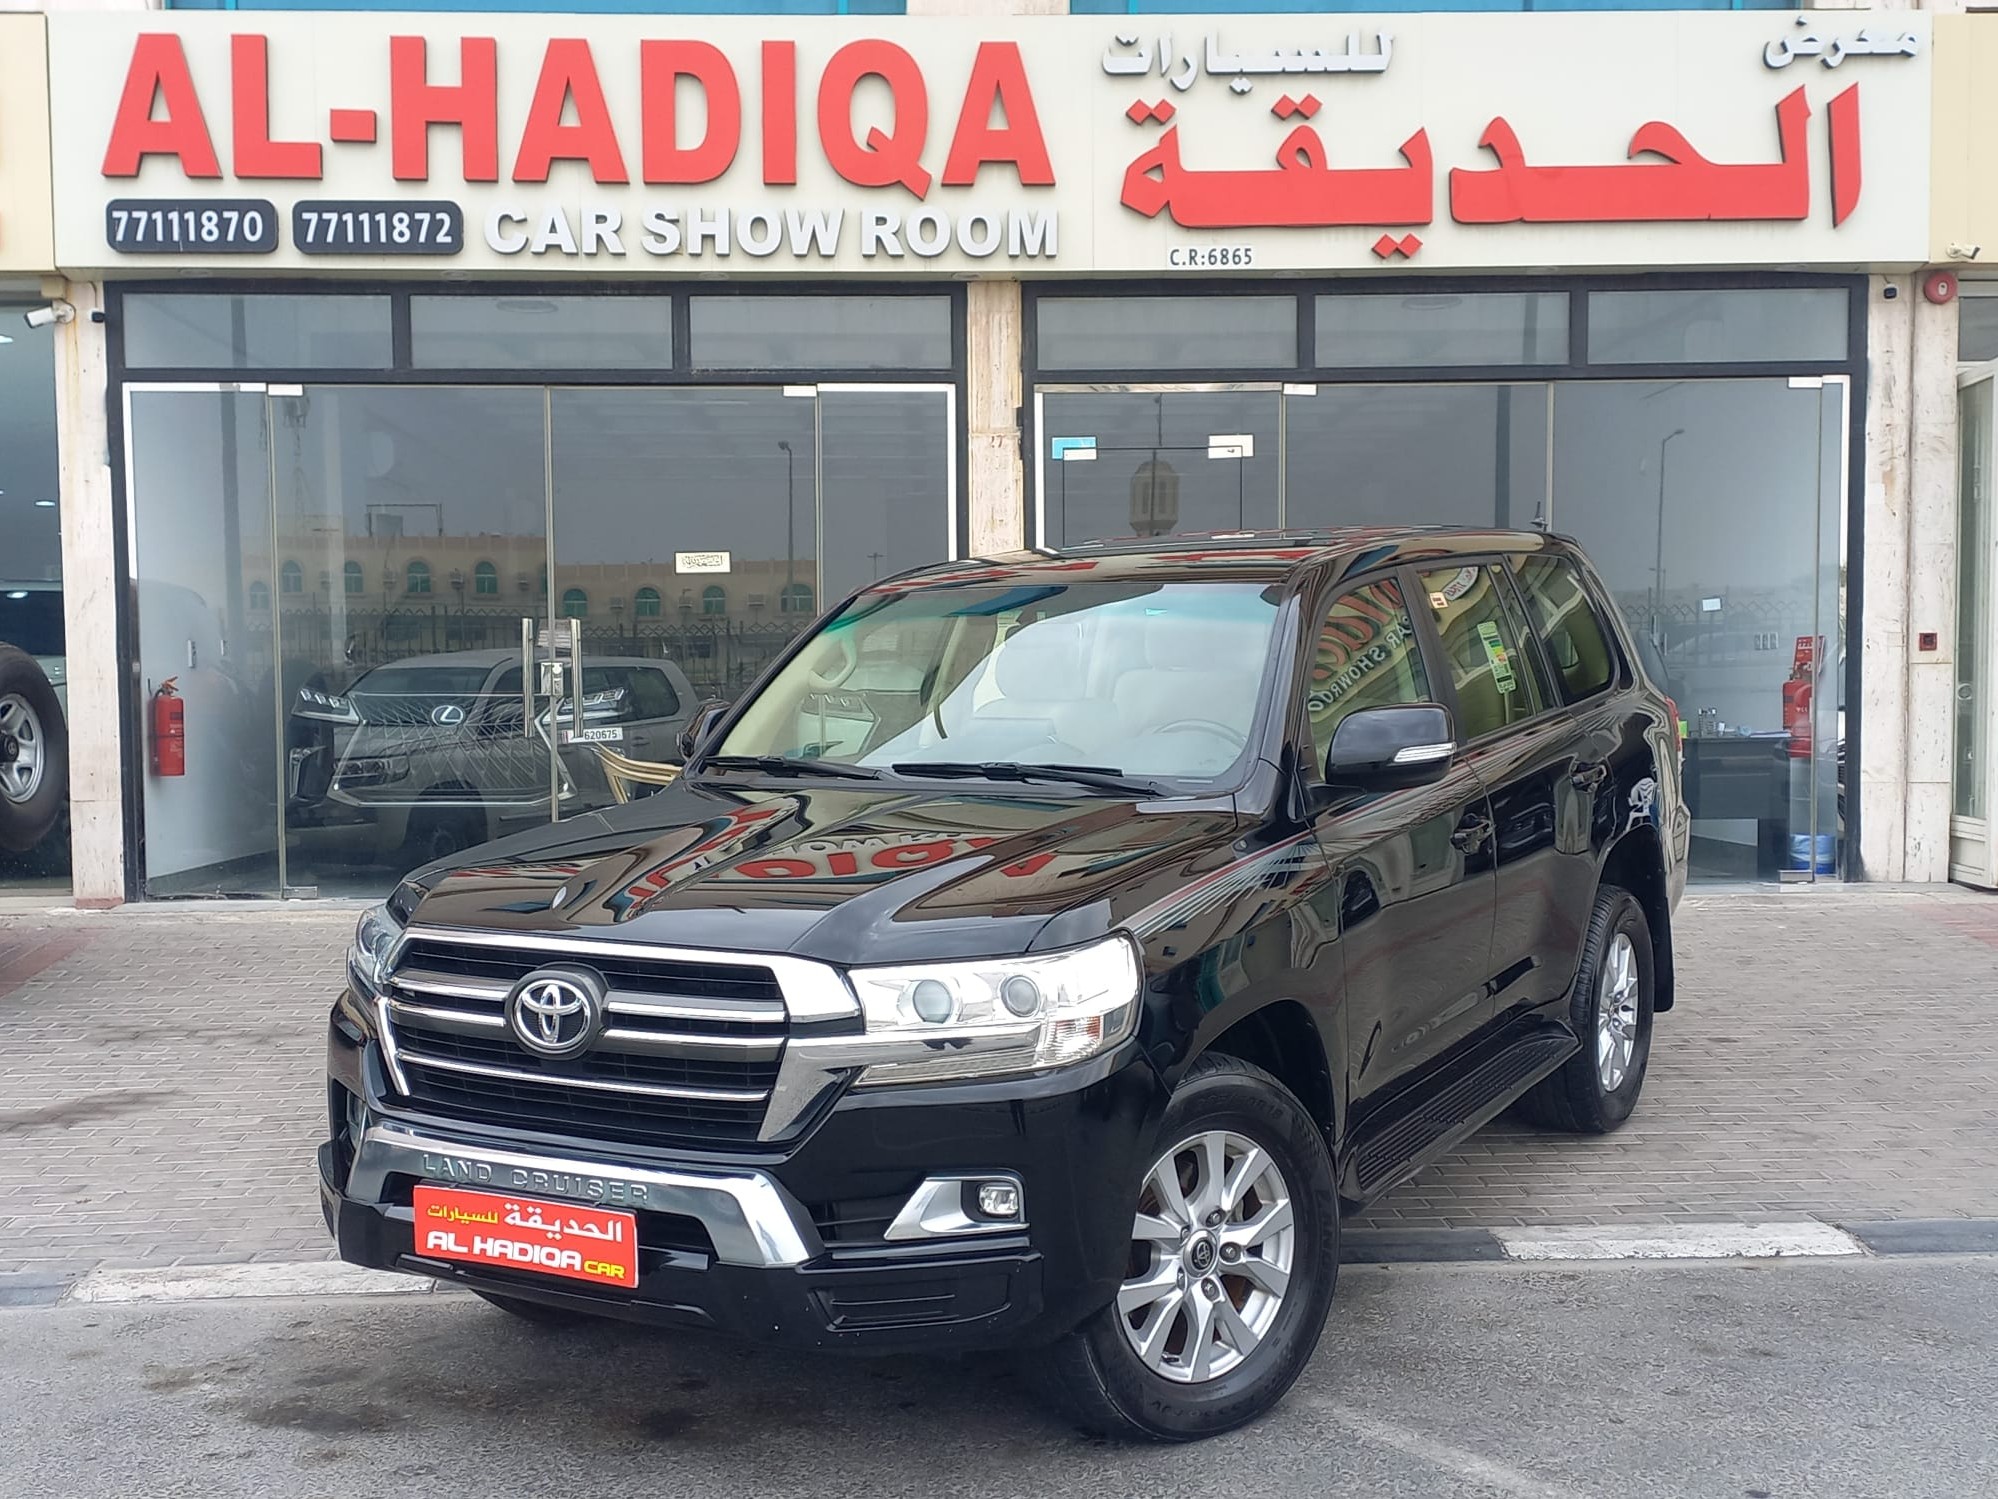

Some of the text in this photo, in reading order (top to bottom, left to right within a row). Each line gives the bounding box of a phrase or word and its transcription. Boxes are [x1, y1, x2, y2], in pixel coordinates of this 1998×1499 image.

[1102, 31, 1396, 93] للسيارات
[1763, 16, 1917, 69] معرض
[102, 33, 1056, 200] AL-HADIQA
[1120, 81, 1862, 259] الحديقة
[112, 210, 263, 242] 77111870
[301, 212, 452, 244] 77111872
[483, 205, 1059, 258] CAR SHOW ROOM
[1169, 247, 1253, 267] C.R:6865
[584, 730, 618, 740] 620675
[423, 1154, 649, 1202] LAND CRUISER
[427, 1202, 623, 1242] الحديقة للسيارات
[427, 1231, 626, 1280] AL HADIQA CAR
